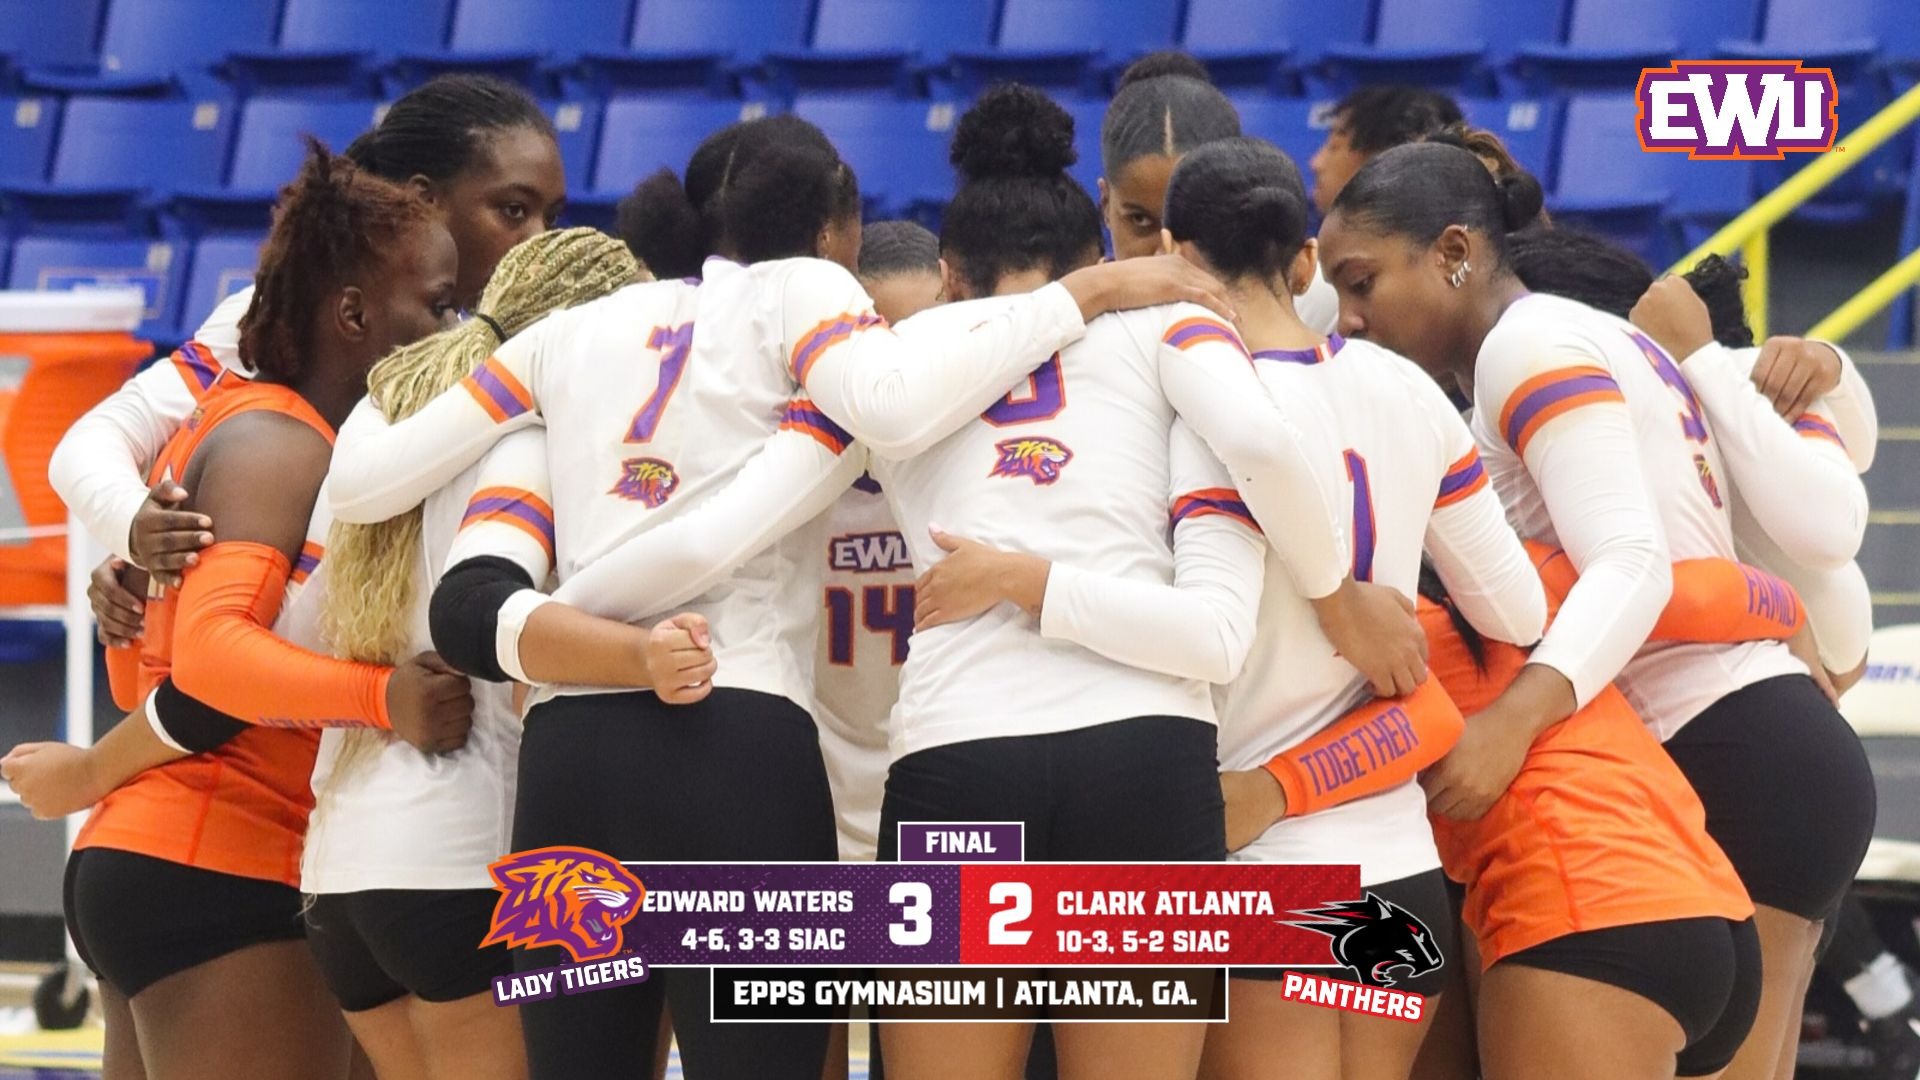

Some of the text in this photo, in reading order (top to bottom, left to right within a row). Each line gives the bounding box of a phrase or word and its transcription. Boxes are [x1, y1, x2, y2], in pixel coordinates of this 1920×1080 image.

[623, 320, 694, 443] 7
[1343, 448, 1377, 583] 1
[824, 584, 916, 667] 14
[1298, 705, 1420, 797] TOGETHER
